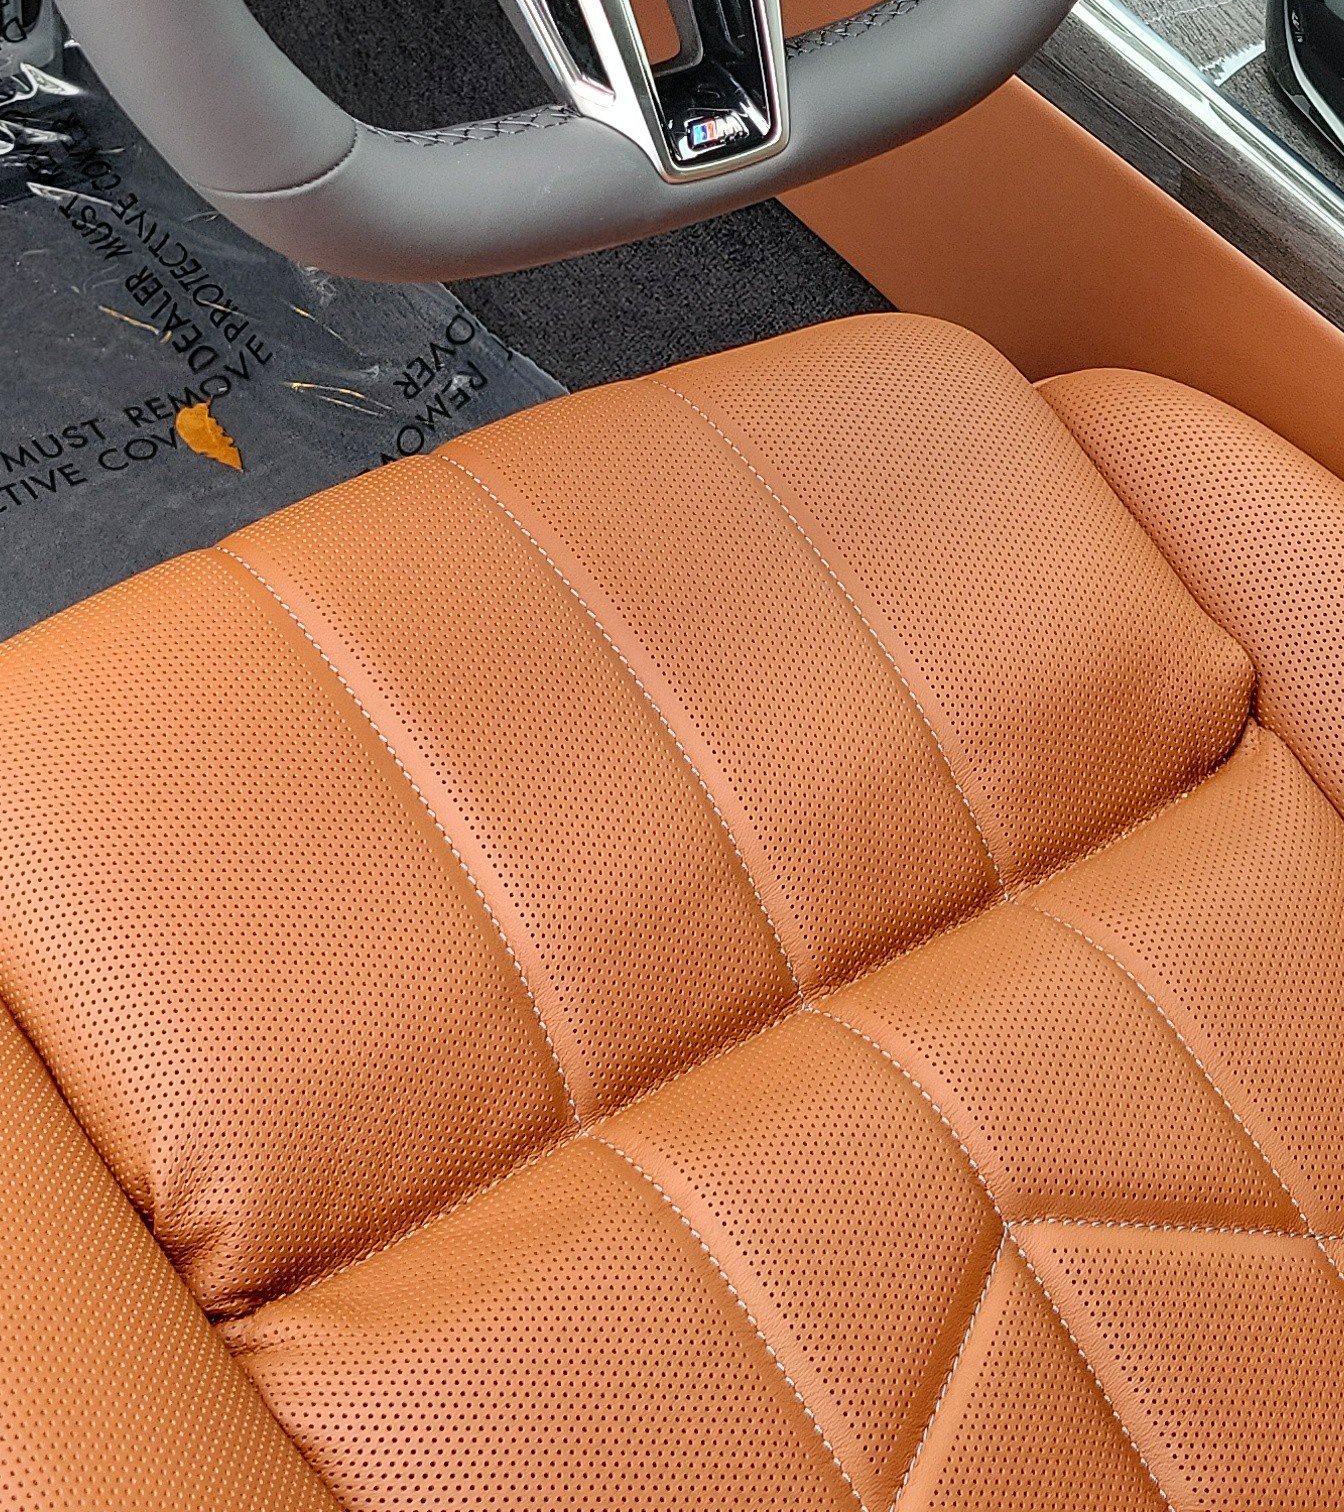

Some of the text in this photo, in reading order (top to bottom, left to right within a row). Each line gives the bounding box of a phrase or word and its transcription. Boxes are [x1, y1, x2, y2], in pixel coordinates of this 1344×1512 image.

[59, 195, 220, 374] DEALER MUST
[111, 192, 251, 344] PROTECTIVE
[0, 418, 106, 473] MUST
[123, 339, 273, 429] REMOVE
[394, 314, 476, 400] OVER
[98, 425, 181, 472] COV
